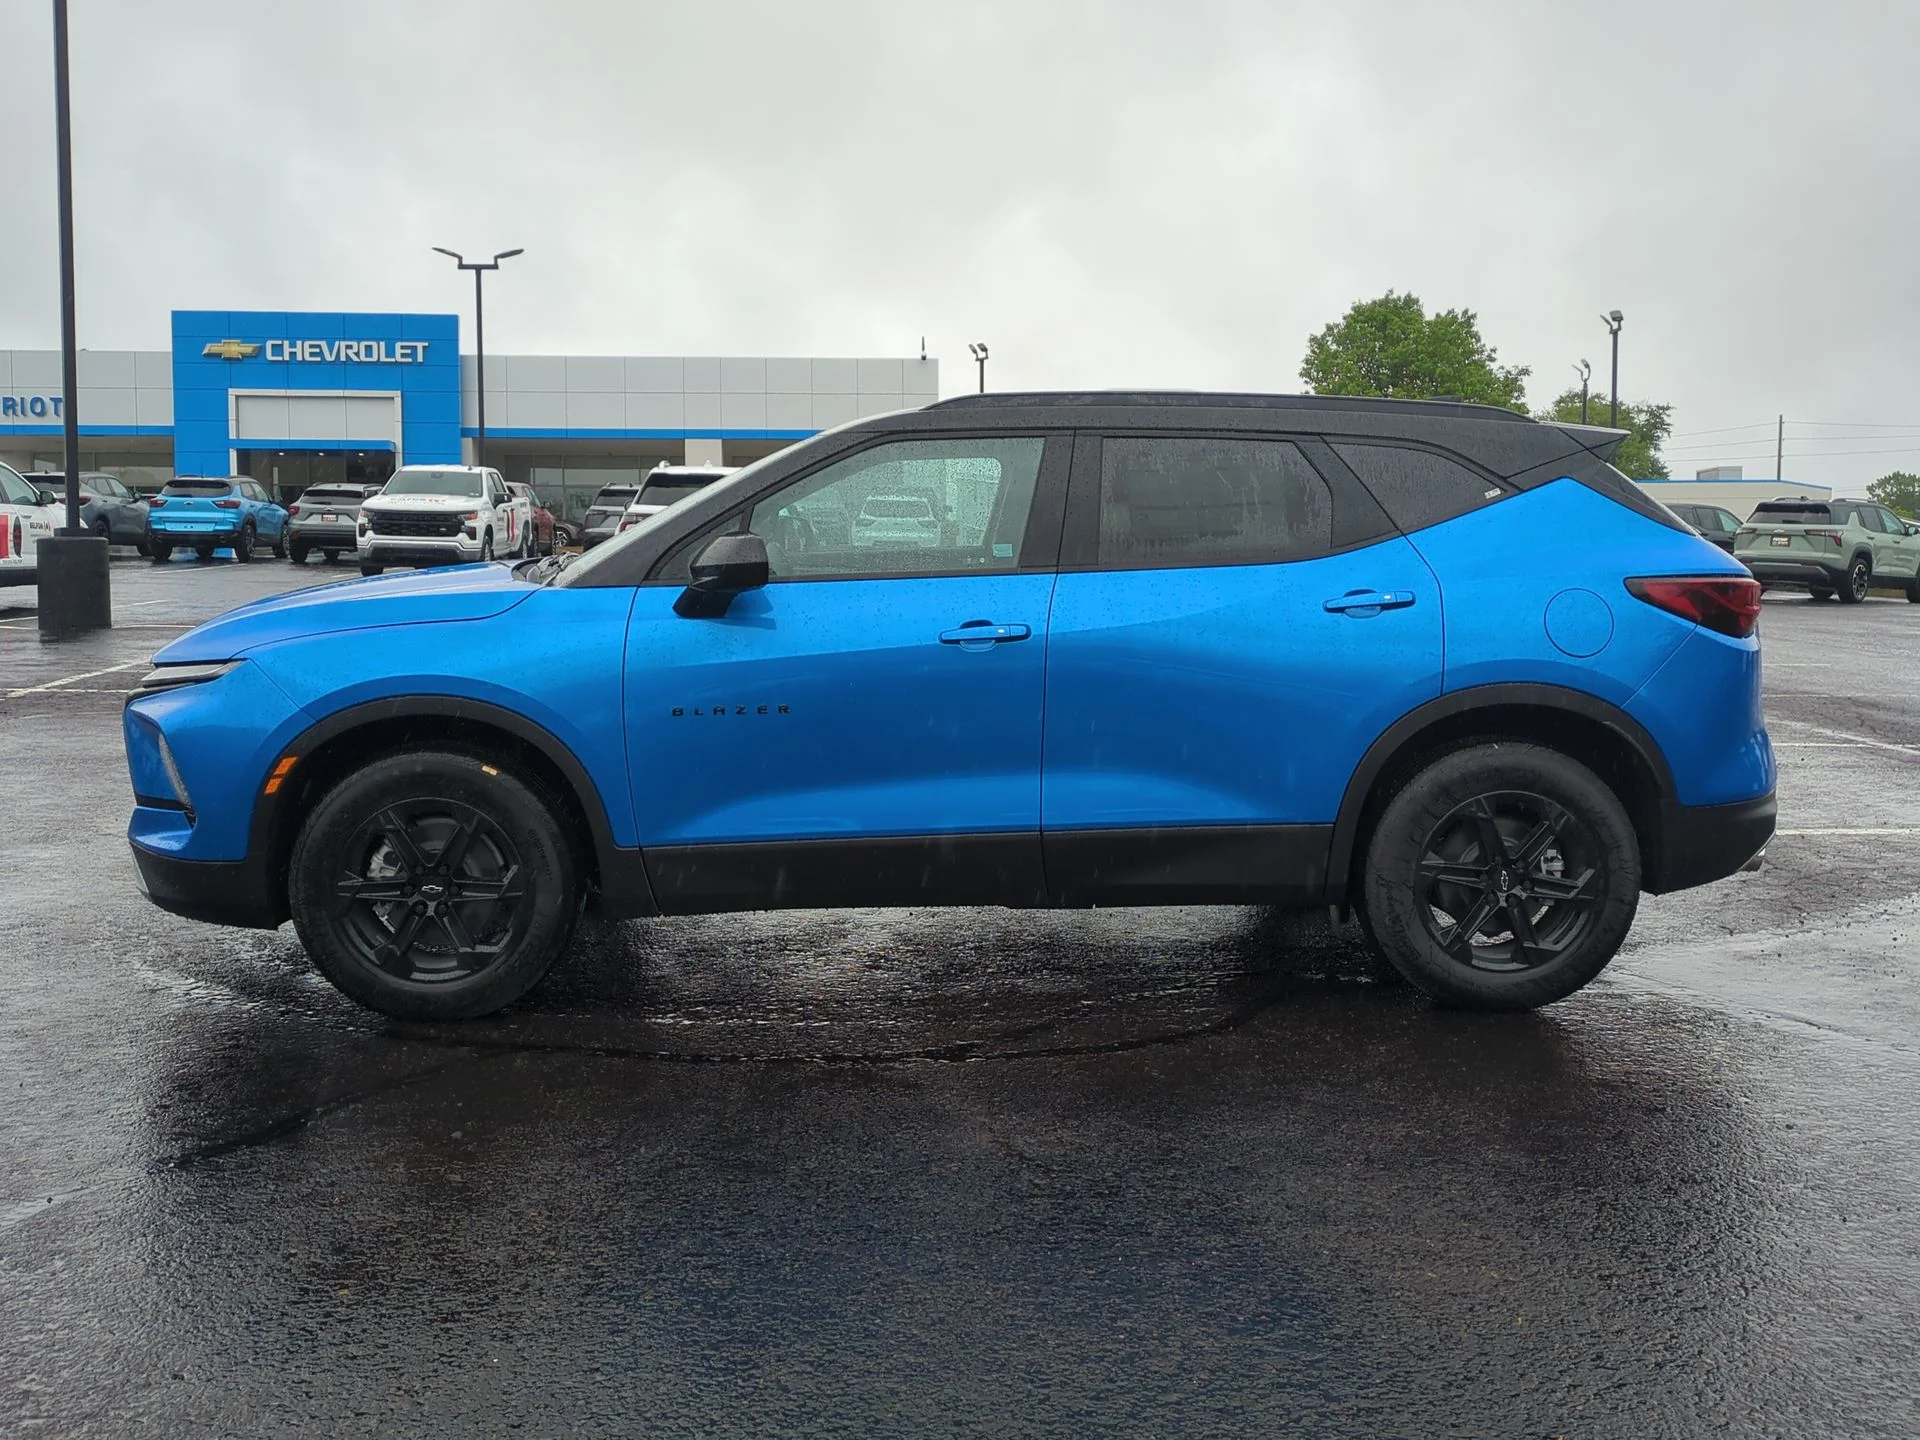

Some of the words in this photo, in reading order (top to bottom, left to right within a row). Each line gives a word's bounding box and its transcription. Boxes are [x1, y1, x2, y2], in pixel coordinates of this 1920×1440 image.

[265, 340, 429, 363] CHEVROLET
[2, 396, 64, 417] RIOT
[671, 704, 792, 717] BLAZER
